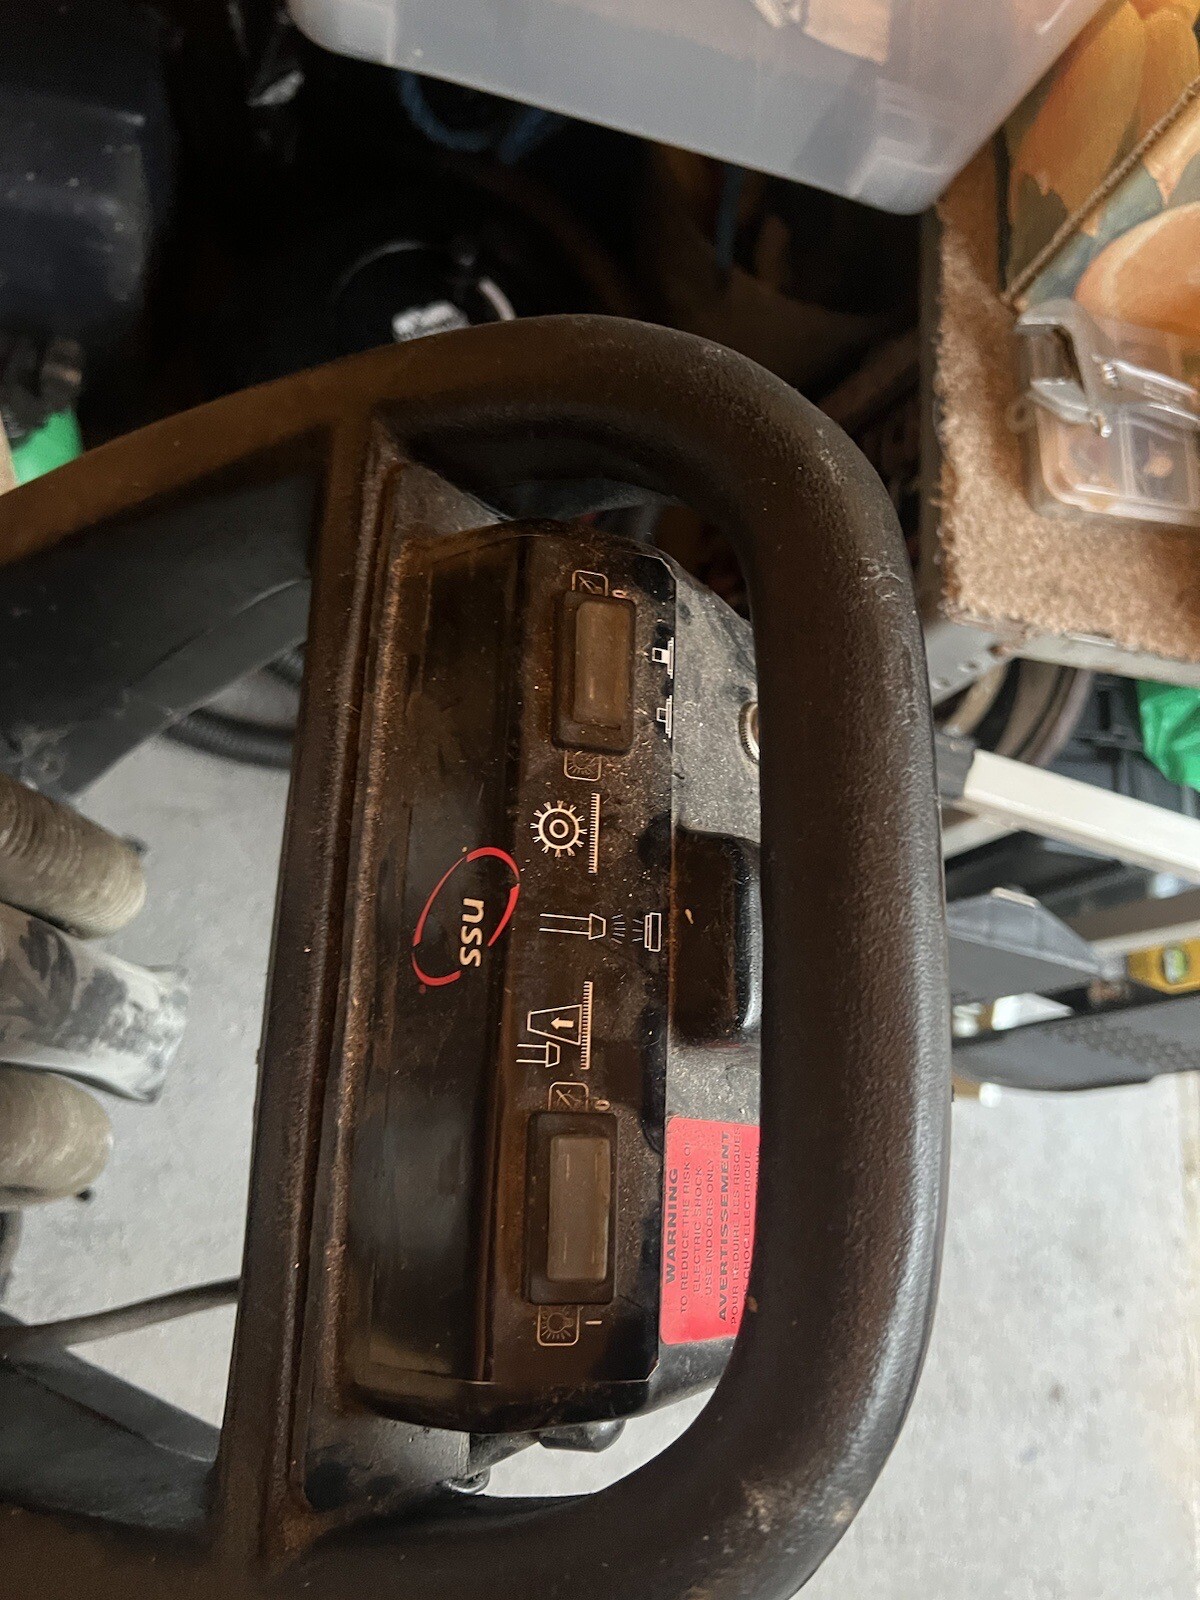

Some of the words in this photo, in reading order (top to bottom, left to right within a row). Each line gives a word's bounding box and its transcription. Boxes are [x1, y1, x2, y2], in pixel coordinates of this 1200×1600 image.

[460, 898, 484, 968] nss
[666, 1168, 678, 1283] WARNING
[694, 1168, 702, 1216] SHOCK
[719, 1131, 729, 1321] AVERTISSEMENT
[693, 1222, 701, 1292] ELECTRIC
[680, 1296, 687, 1313] TO
